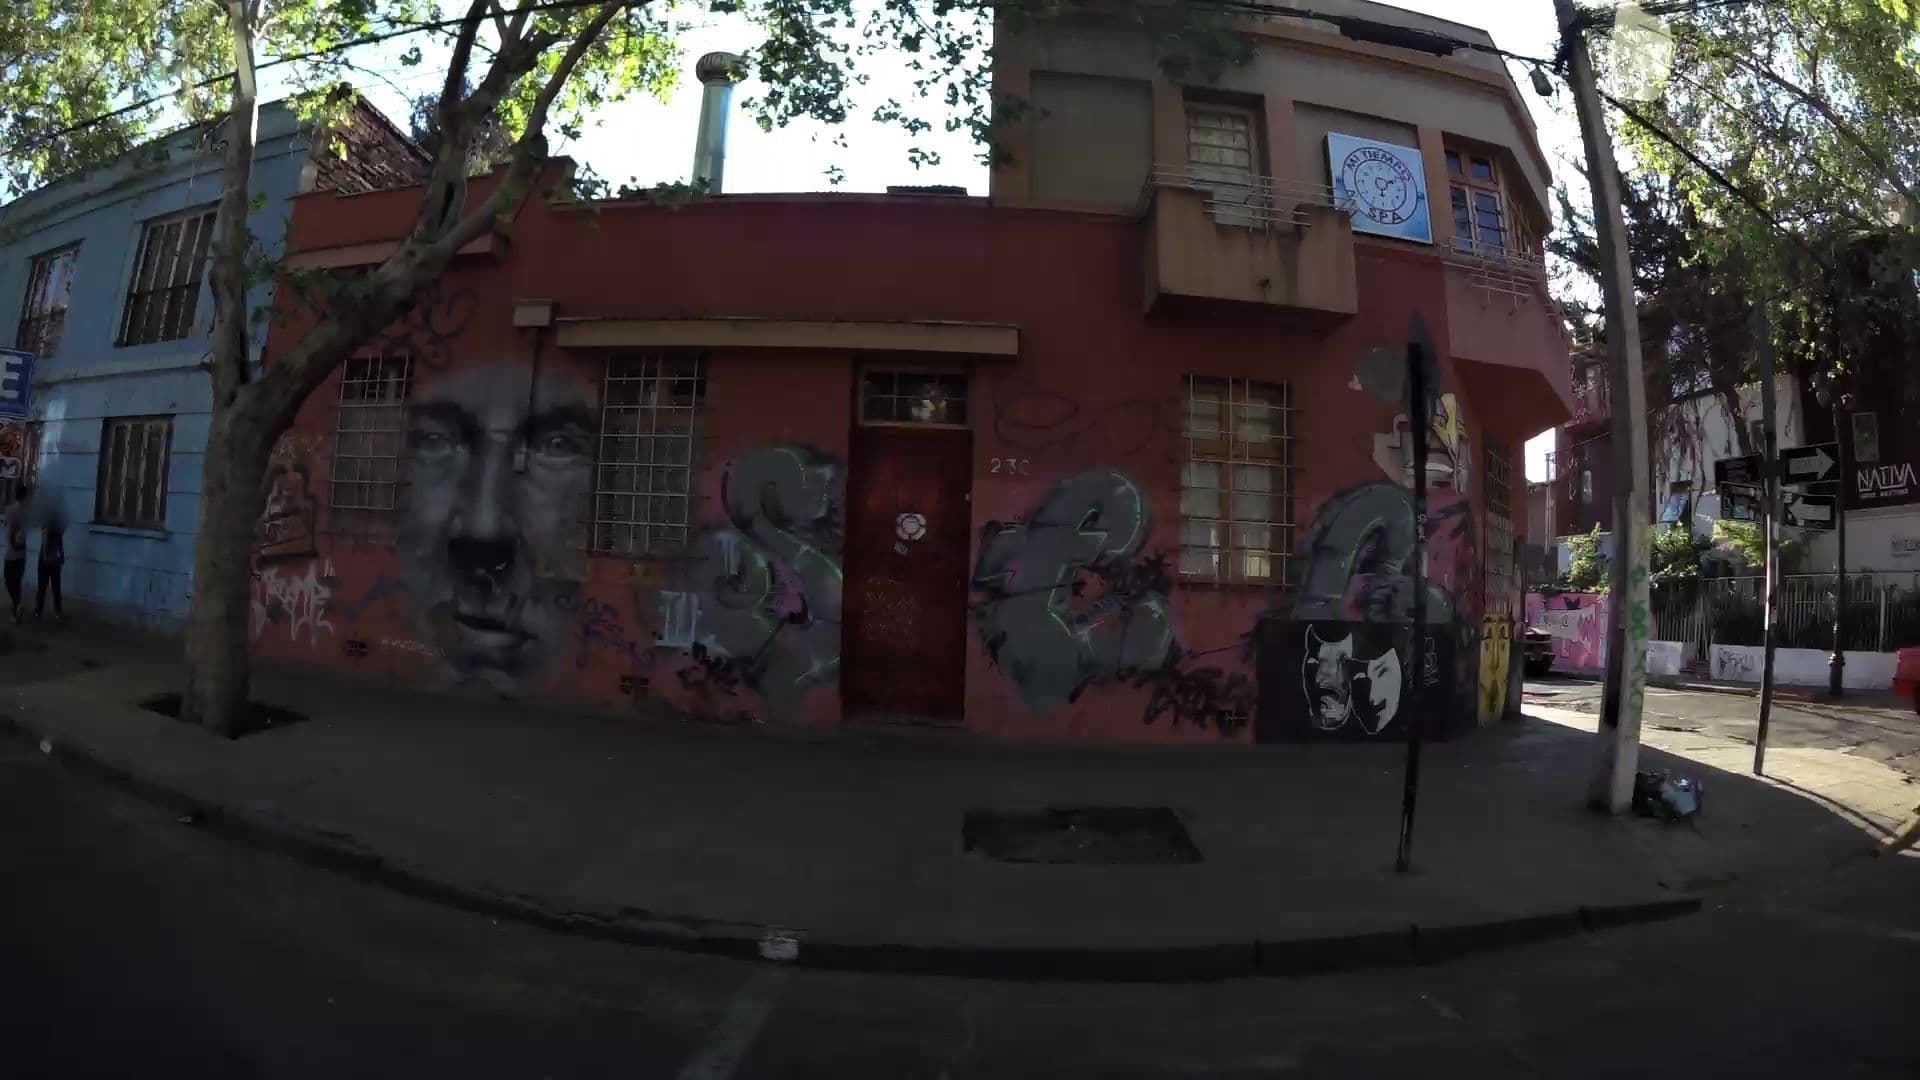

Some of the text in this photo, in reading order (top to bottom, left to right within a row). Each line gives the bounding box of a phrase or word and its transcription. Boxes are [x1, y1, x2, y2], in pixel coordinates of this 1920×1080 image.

[1346, 149, 1412, 182] MI TIEMPO
[1366, 207, 1405, 223] SPA
[1857, 462, 1918, 492] NATIVA
